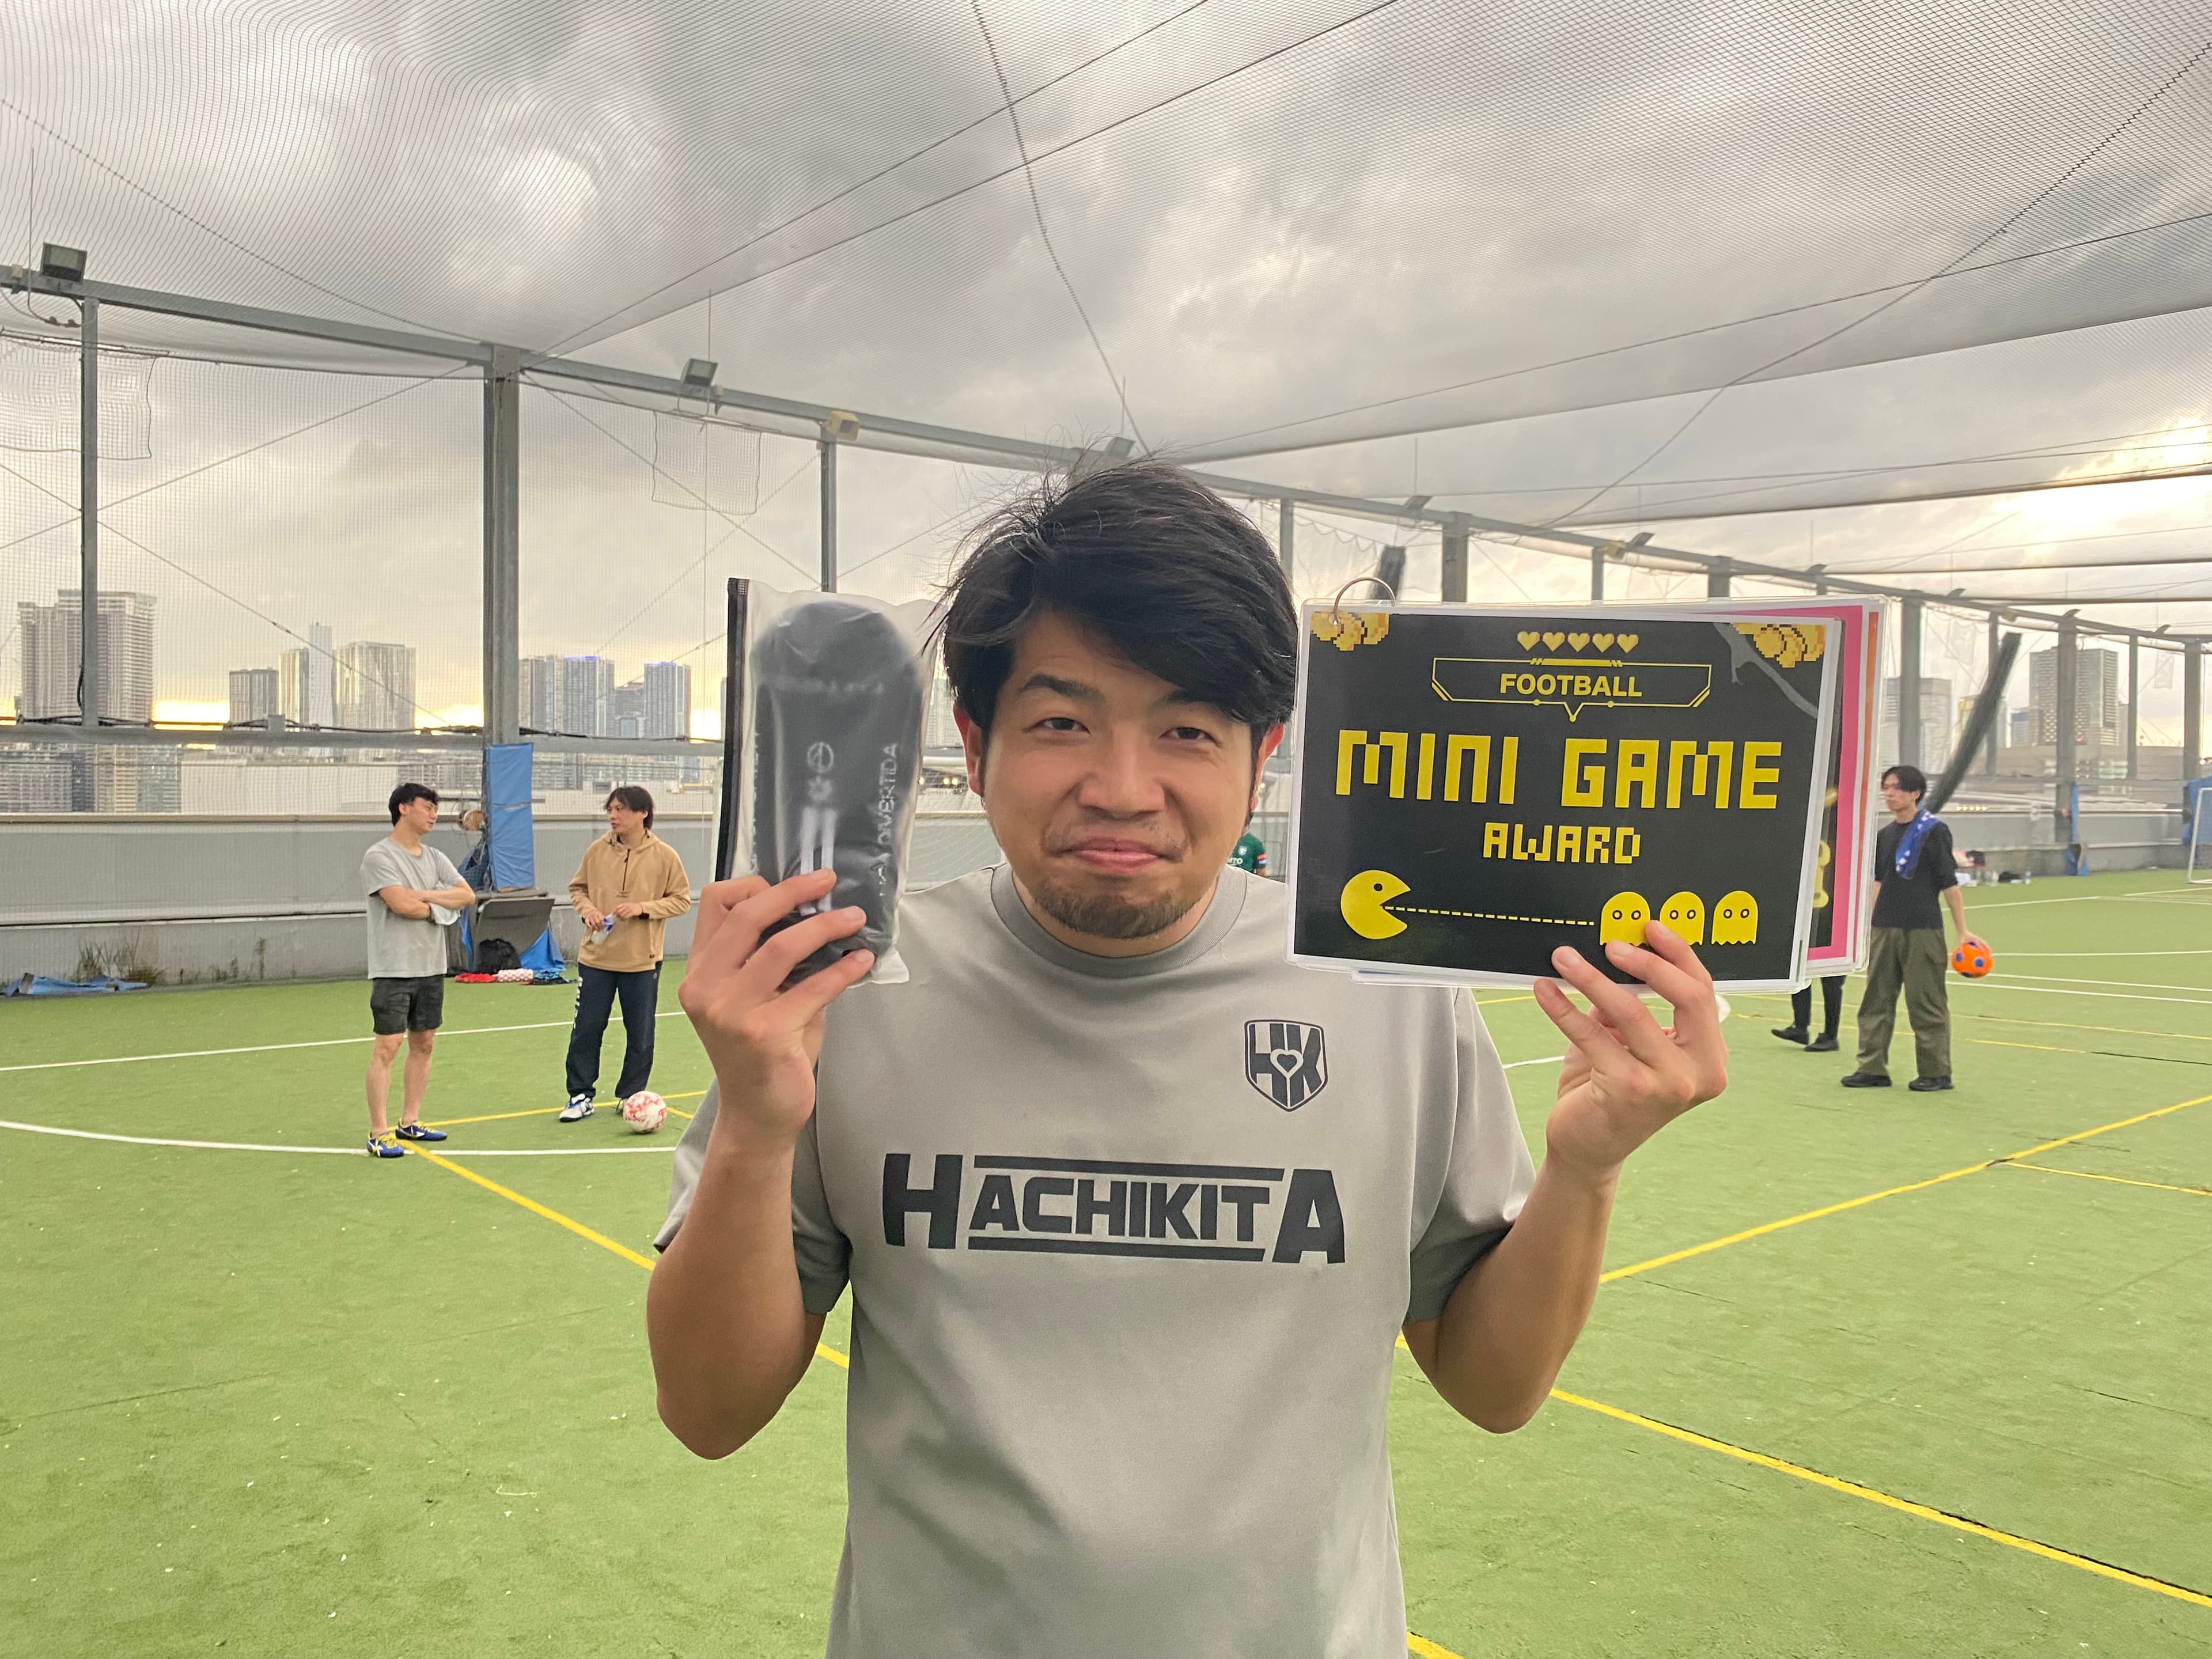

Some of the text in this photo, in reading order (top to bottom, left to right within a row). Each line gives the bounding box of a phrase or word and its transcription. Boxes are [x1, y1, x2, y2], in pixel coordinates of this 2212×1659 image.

[1499, 673, 1642, 698] FOOTBALL
[1335, 729, 1782, 809] MINI GAME
[1483, 822, 1641, 865] AWARD
[882, 1153, 1346, 1264] HACHIKITA
